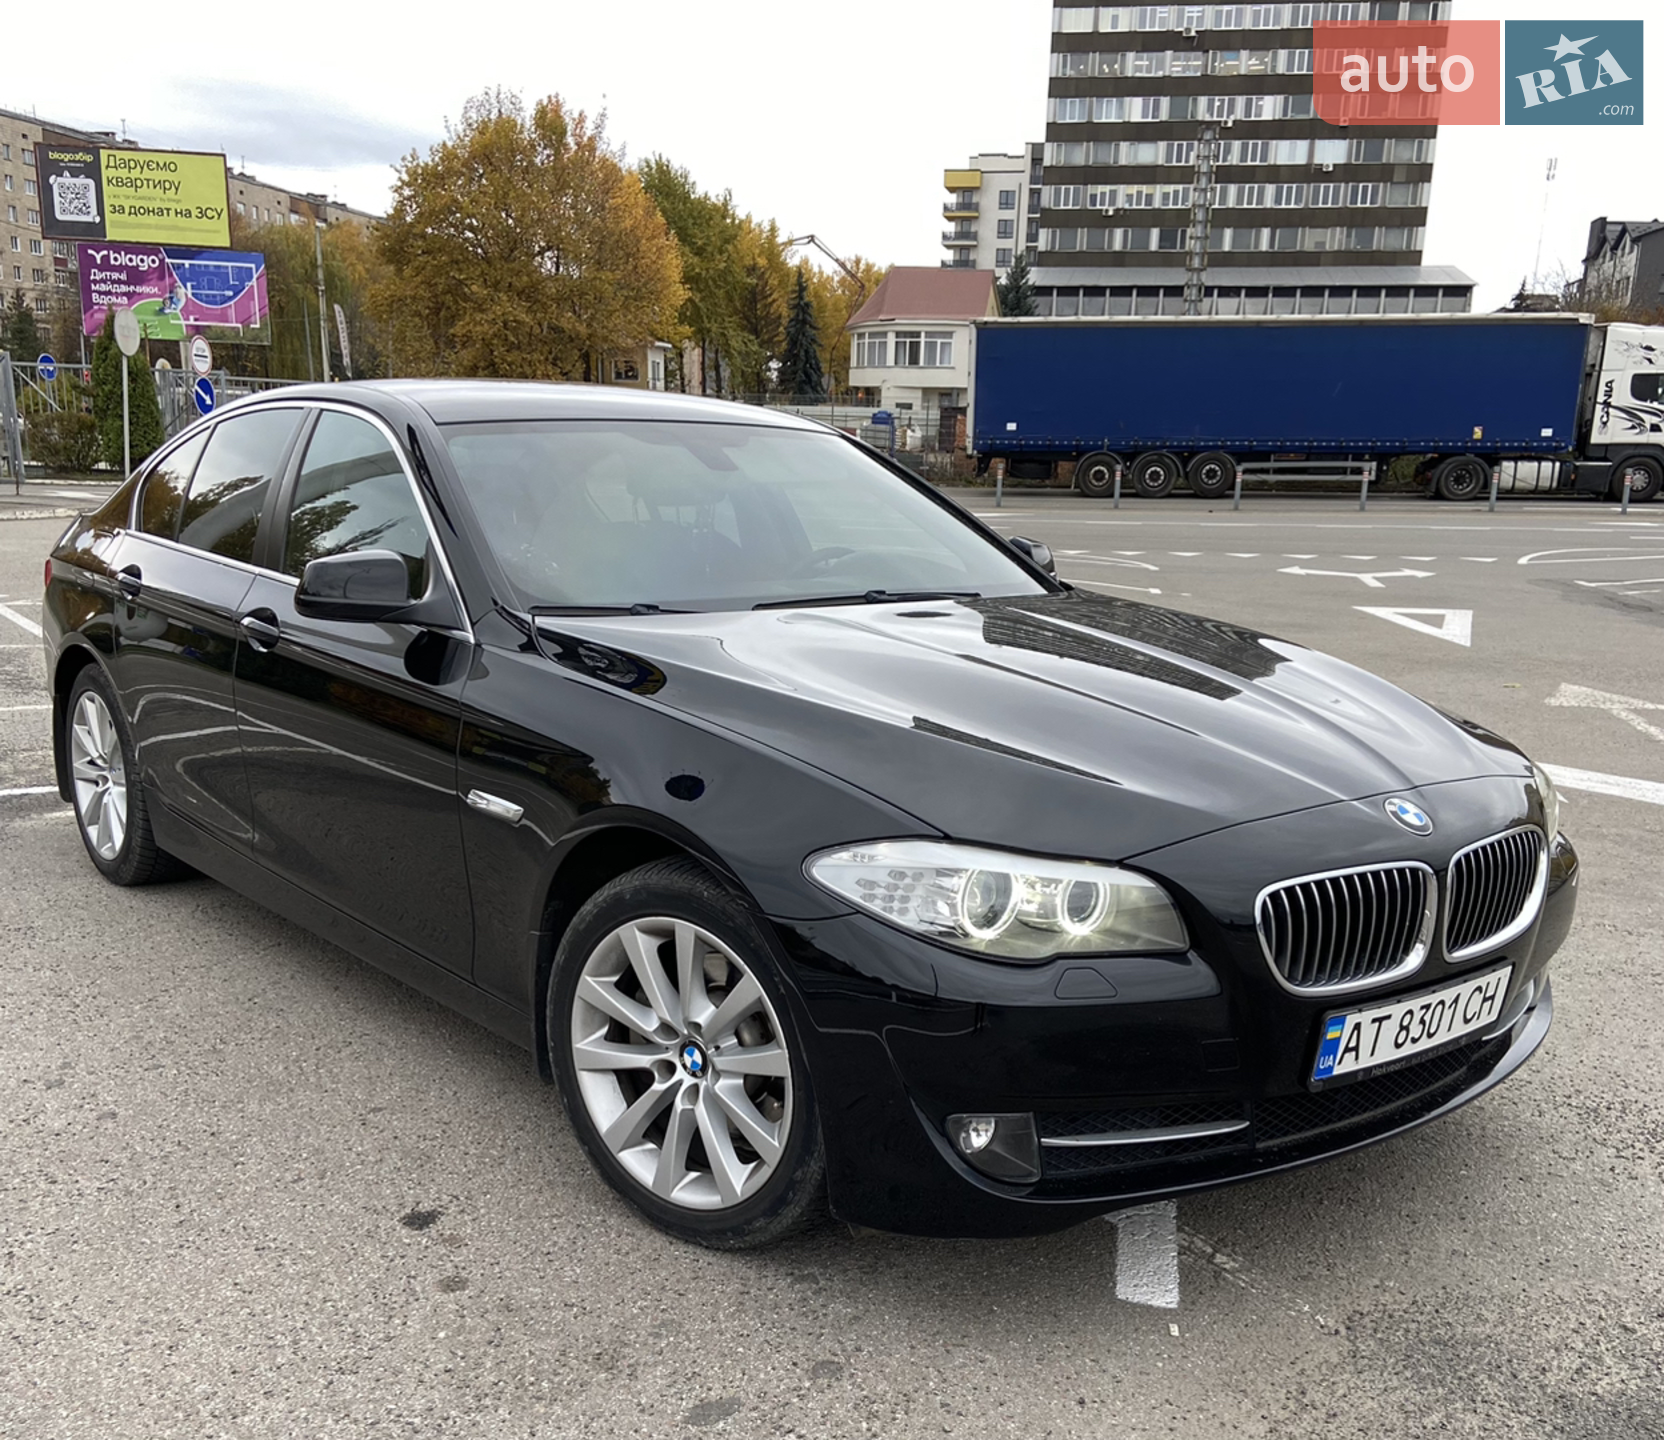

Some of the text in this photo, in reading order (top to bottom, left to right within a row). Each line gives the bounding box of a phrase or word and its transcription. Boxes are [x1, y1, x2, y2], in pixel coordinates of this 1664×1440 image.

[105, 154, 178, 174] Даруємо
[106, 175, 181, 195] квартиру
[109, 203, 224, 221] за донат на ЗСУ
[109, 250, 160, 271] blago
[90, 268, 127, 281] Дитячі
[91, 281, 161, 294] майданчики.
[92, 293, 128, 305] Вдома
[1337, 977, 1501, 1066] AT 8301 CH
[1318, 1053, 1334, 1070] UA
